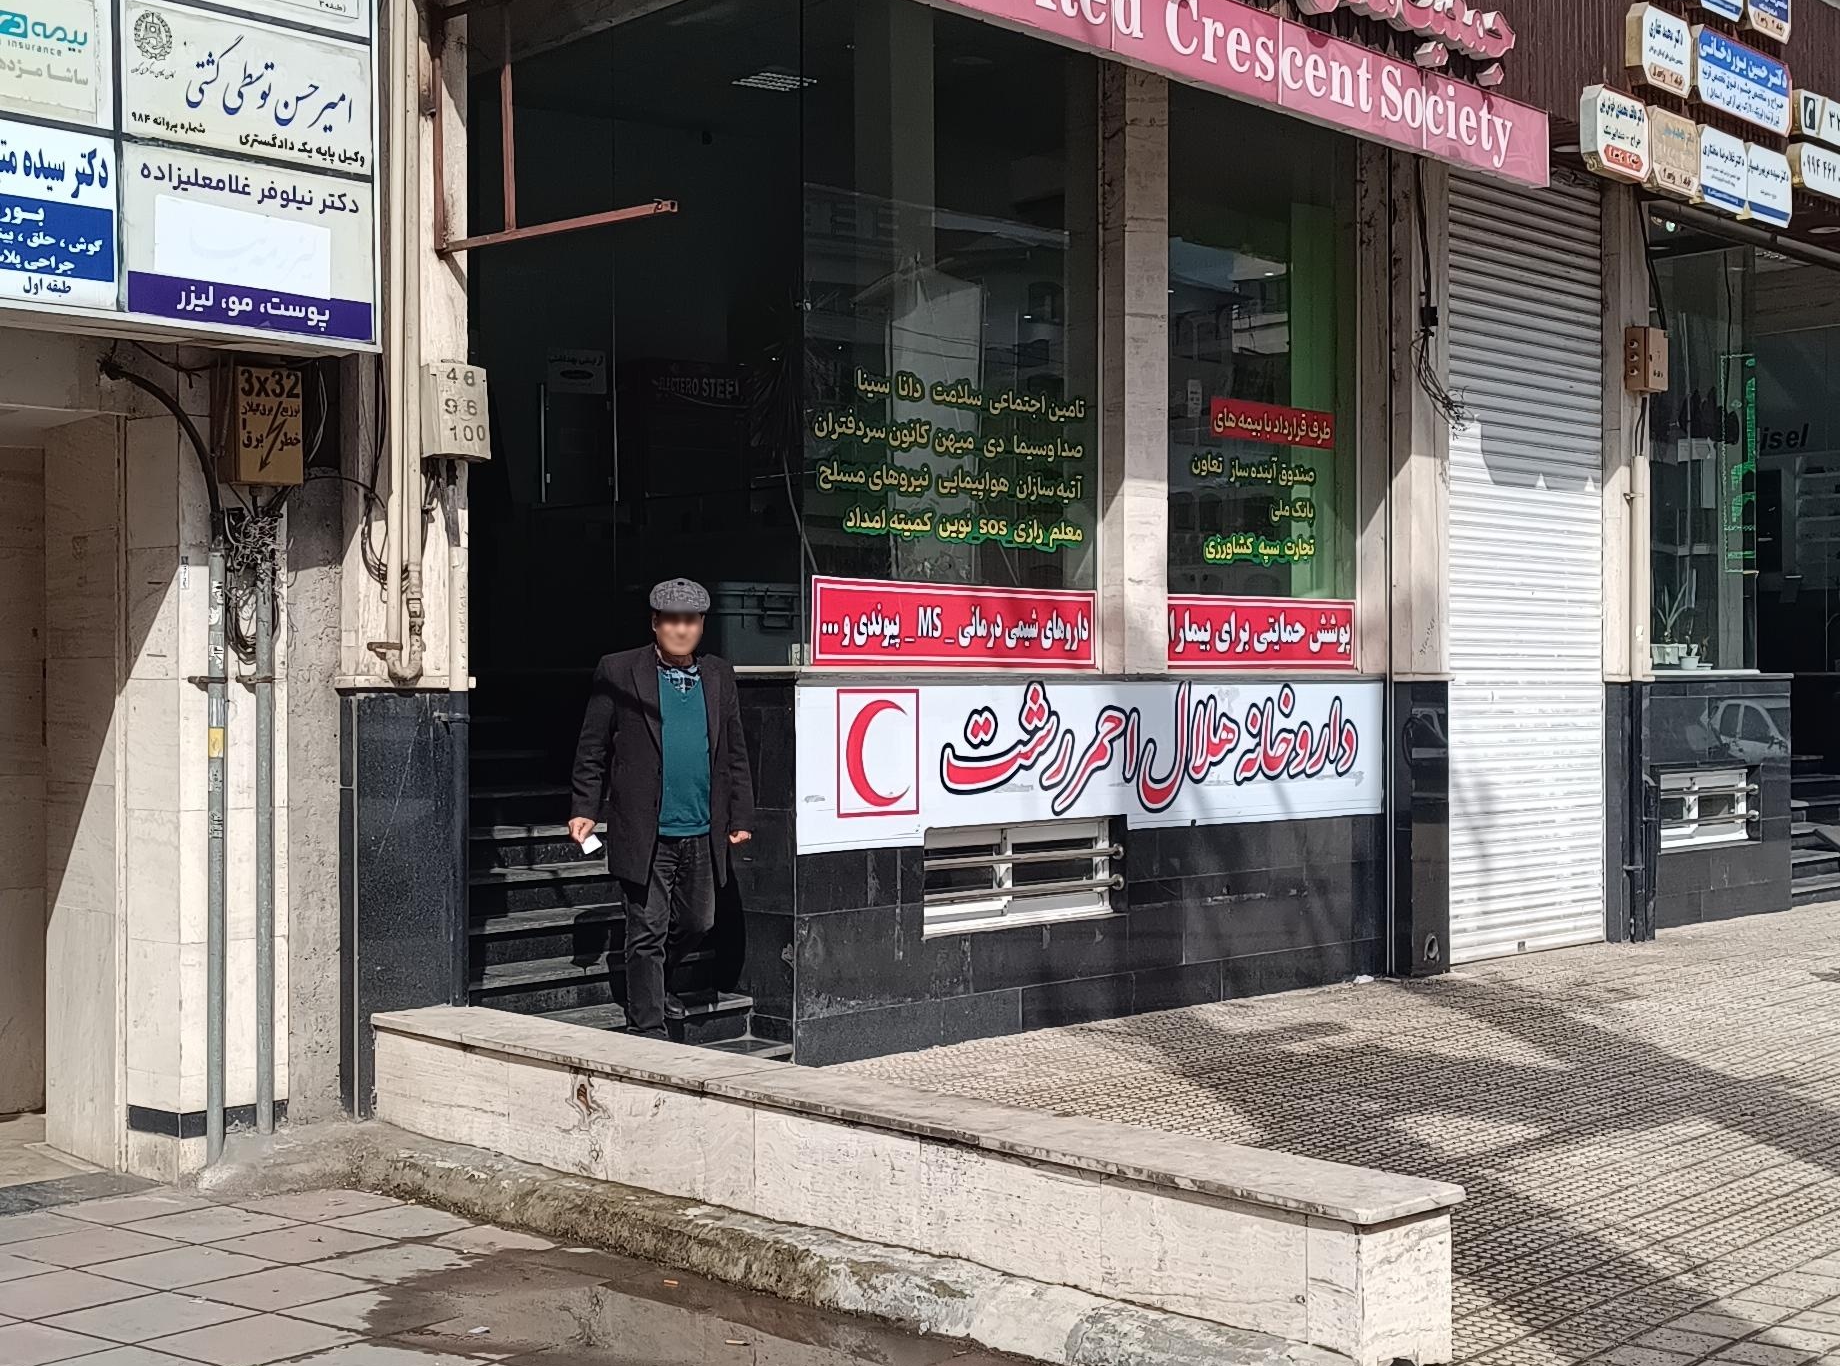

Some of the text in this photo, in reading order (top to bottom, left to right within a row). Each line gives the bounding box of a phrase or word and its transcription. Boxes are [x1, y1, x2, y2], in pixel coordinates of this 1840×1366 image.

[32, 21, 88, 54] بیمه
[46, 63, 88, 86] ساشا
[1767, 68, 1788, 89] دکتر
[131, 110, 206, 135] شماره پروانه ۹۸۴
[1380, 75, 1514, 170] Society
[239, 133, 365, 168] وکیل پایه یک دادگستری
[23, 147, 109, 199] دکتر سیده
[140, 162, 360, 215] دکتر نیلوفر غلامعلیزاده
[24, 254, 75, 275] جراحی
[23, 275, 72, 298] طبقه اول
[176, 285, 214, 311] لیزر
[856, 368, 1086, 423] تامین اجتماعی سلامت دانا سینا
[242, 430, 301, 452] خطر برق
[814, 408, 1004, 458] دی میهن کانون سردفتران
[1213, 407, 1331, 445] طرف قرارداد با بیمه های
[818, 464, 865, 489] مسلح
[869, 467, 929, 493] نیروهای
[938, 469, 1010, 499] هواپیمایی
[1191, 453, 1315, 486] صندوق آینده ساز تعاون
[1016, 475, 1054, 500] سازان
[845, 507, 886, 530] امداد
[889, 511, 932, 536] کمیته
[937, 513, 972, 539] نوین
[1270, 499, 1314, 525] بانک ملی
[1013, 519, 1044, 544] رازی
[1050, 522, 1083, 547] معلم
[1204, 534, 1315, 563] تجارت سپه کشاورزی
[841, 614, 851, 646] و
[853, 603, 901, 649] پیوندی
[917, 605, 942, 638] MS
[958, 605, 1002, 648] درمانی
[1005, 608, 1039, 649] شیمی
[1041, 609, 1090, 650] داروهای
[1215, 609, 1250, 653] برای
[1253, 609, 1306, 653] حمایتی
[1309, 612, 1351, 654] پوشش
[940, 680, 1359, 815] داروخانه هلال احمر رشت
